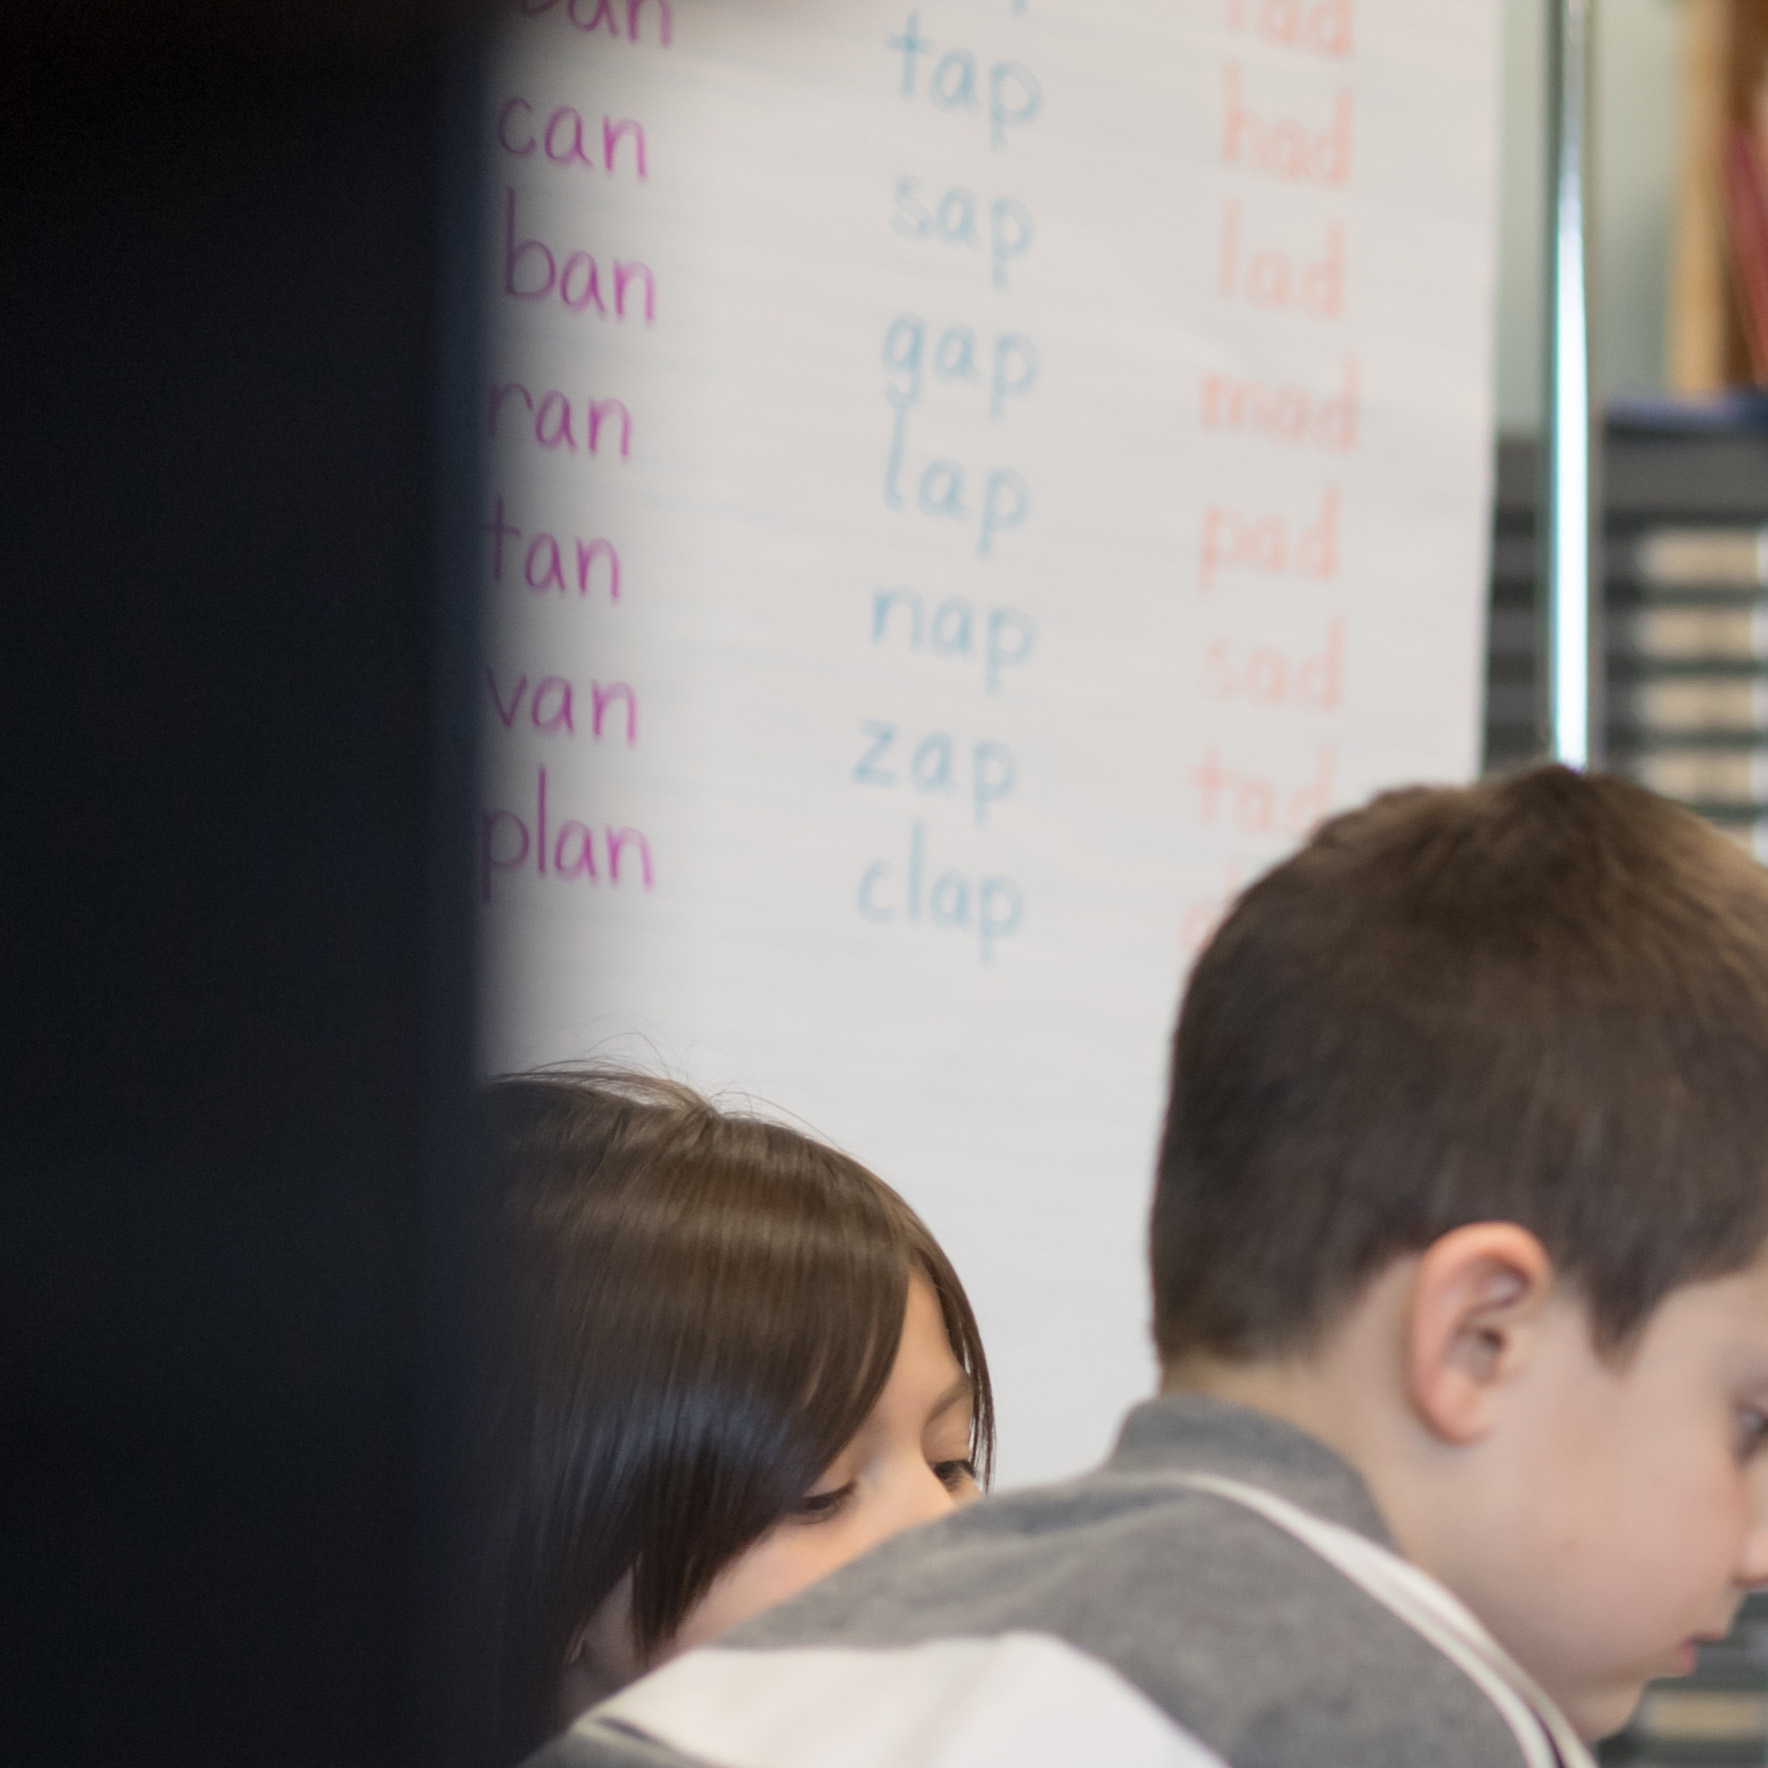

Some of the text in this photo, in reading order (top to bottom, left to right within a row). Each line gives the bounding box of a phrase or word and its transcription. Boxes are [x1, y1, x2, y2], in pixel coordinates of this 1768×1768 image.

[519, 0, 674, 46] an
[886, 10, 1042, 149] tap
[1221, 62, 1354, 188] had
[499, 97, 649, 180] can
[503, 187, 656, 324] ban
[892, 175, 1034, 291] sap
[1216, 197, 1347, 320] lad
[489, 382, 633, 459] ran
[882, 312, 1039, 421] gap
[1199, 354, 1361, 453] mad
[883, 403, 1030, 559] lap
[485, 493, 622, 602] tan
[1196, 485, 1342, 594] pad
[869, 585, 1035, 694] nap
[1197, 613, 1347, 714] sad
[485, 662, 638, 747] van
[849, 719, 1019, 830] zap
[479, 763, 656, 902] plan
[855, 814, 1025, 967] clap
